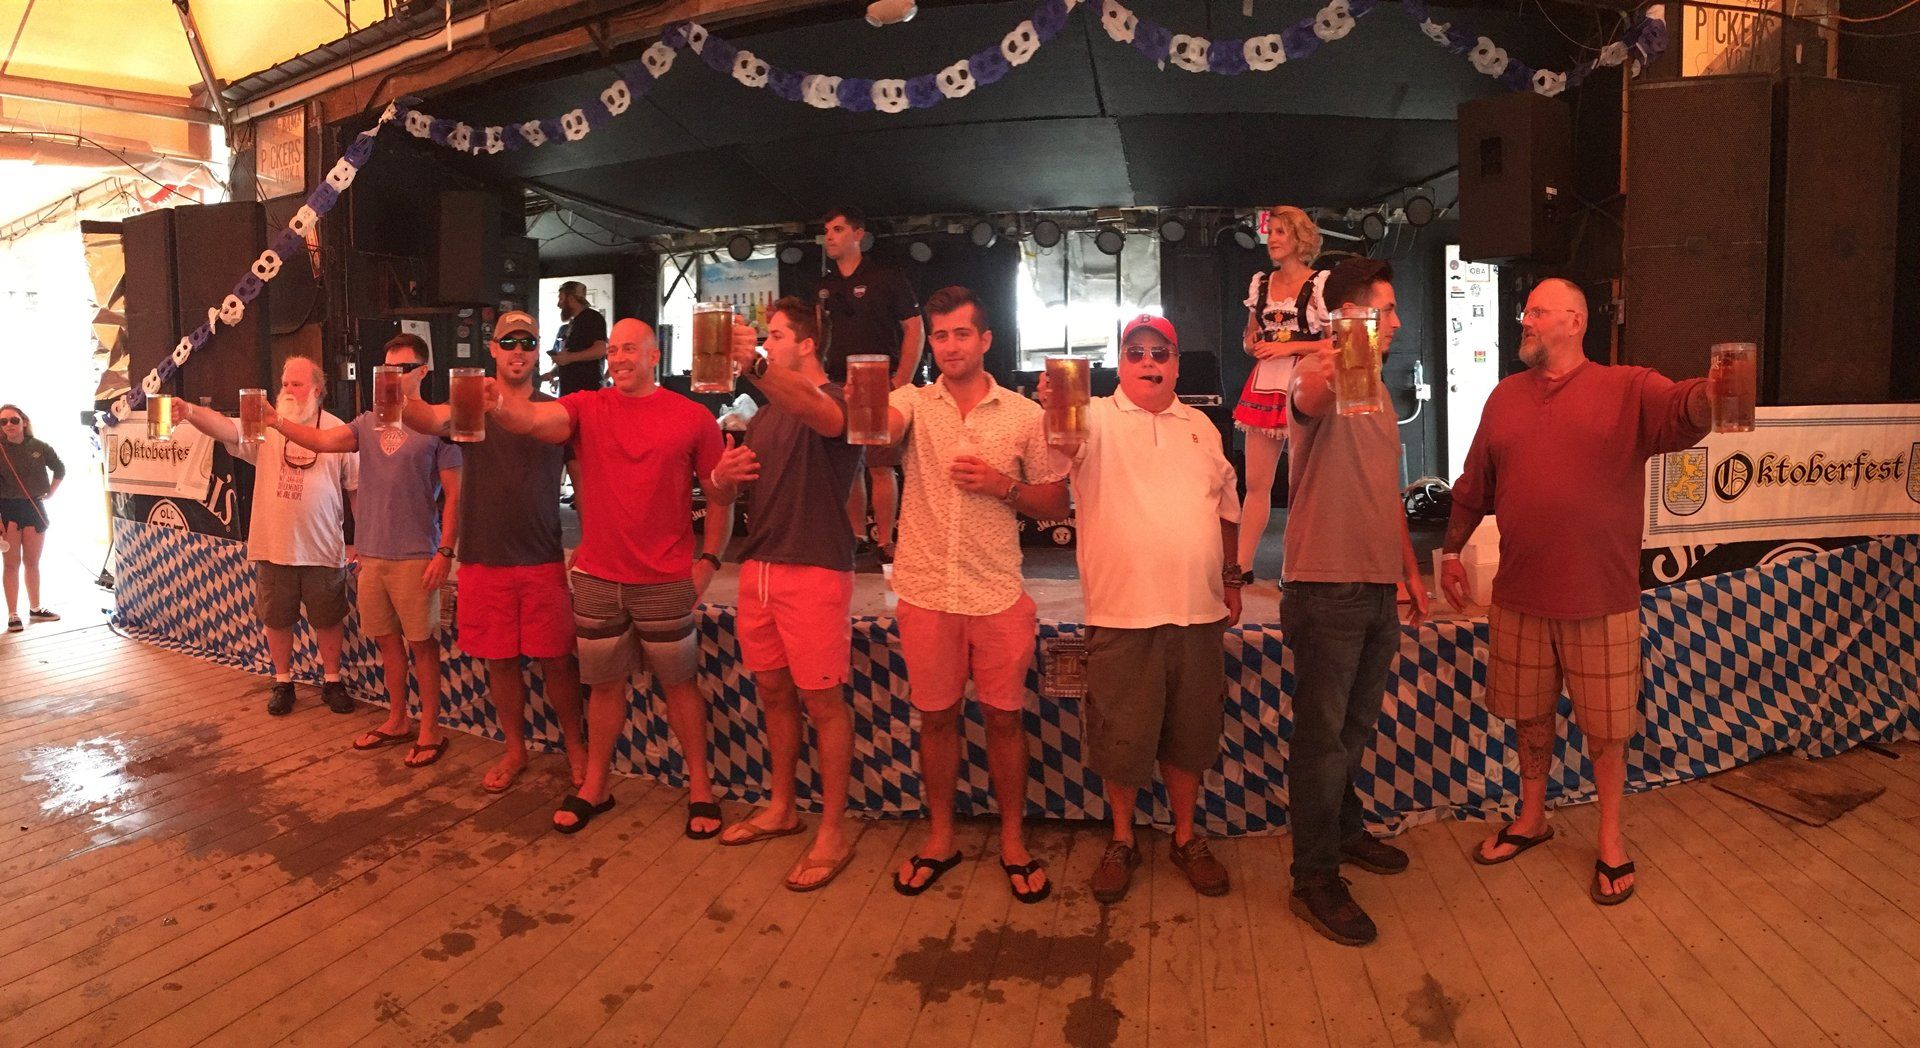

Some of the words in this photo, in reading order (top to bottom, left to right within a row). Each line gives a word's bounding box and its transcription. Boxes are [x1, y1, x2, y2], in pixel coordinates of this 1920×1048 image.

[119, 438, 190, 467] Oktoberfes
[1713, 450, 1906, 503] Oktoberfest
[160, 509, 175, 520] OLD
